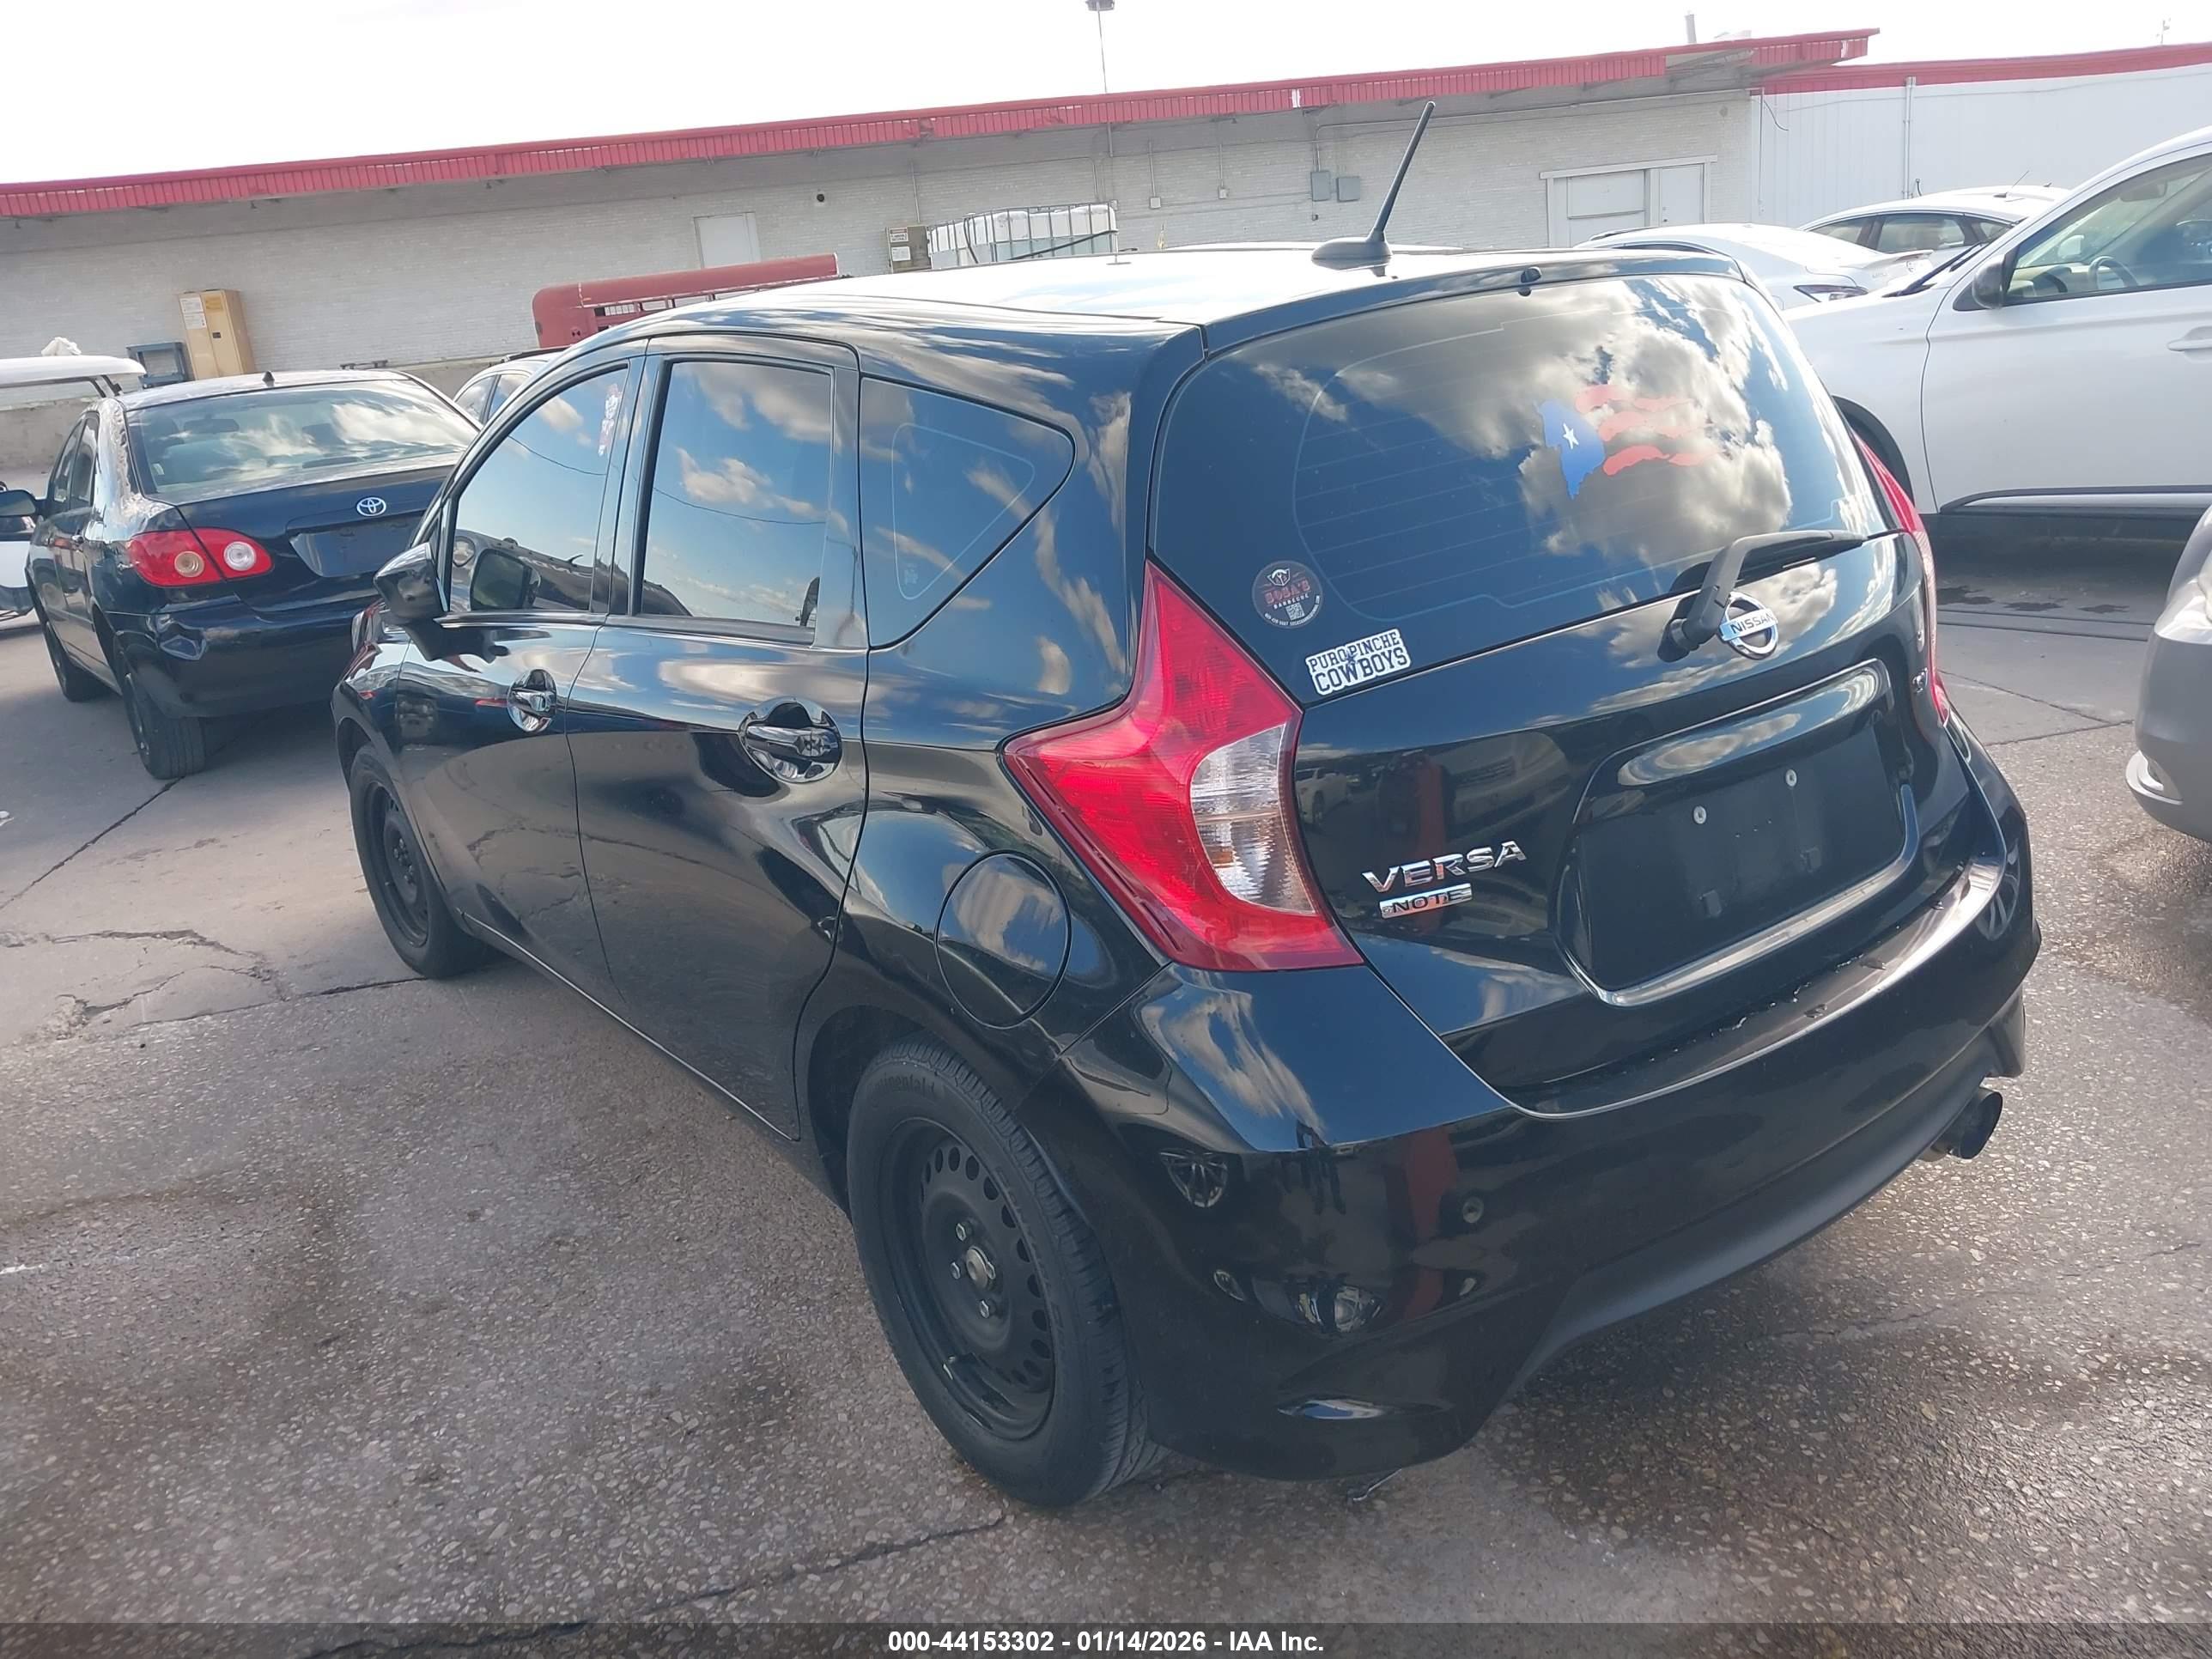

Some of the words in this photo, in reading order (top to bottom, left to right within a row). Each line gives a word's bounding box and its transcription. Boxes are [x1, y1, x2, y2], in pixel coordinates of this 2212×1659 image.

[1729, 612, 1776, 635] NISSAN
[1308, 648, 1347, 673] PURO
[1349, 631, 1401, 659] PINCHE
[1315, 647, 1408, 692] COWBOYS
[1361, 840, 1528, 893] VERSA
[1392, 886, 1472, 914] NOTE
